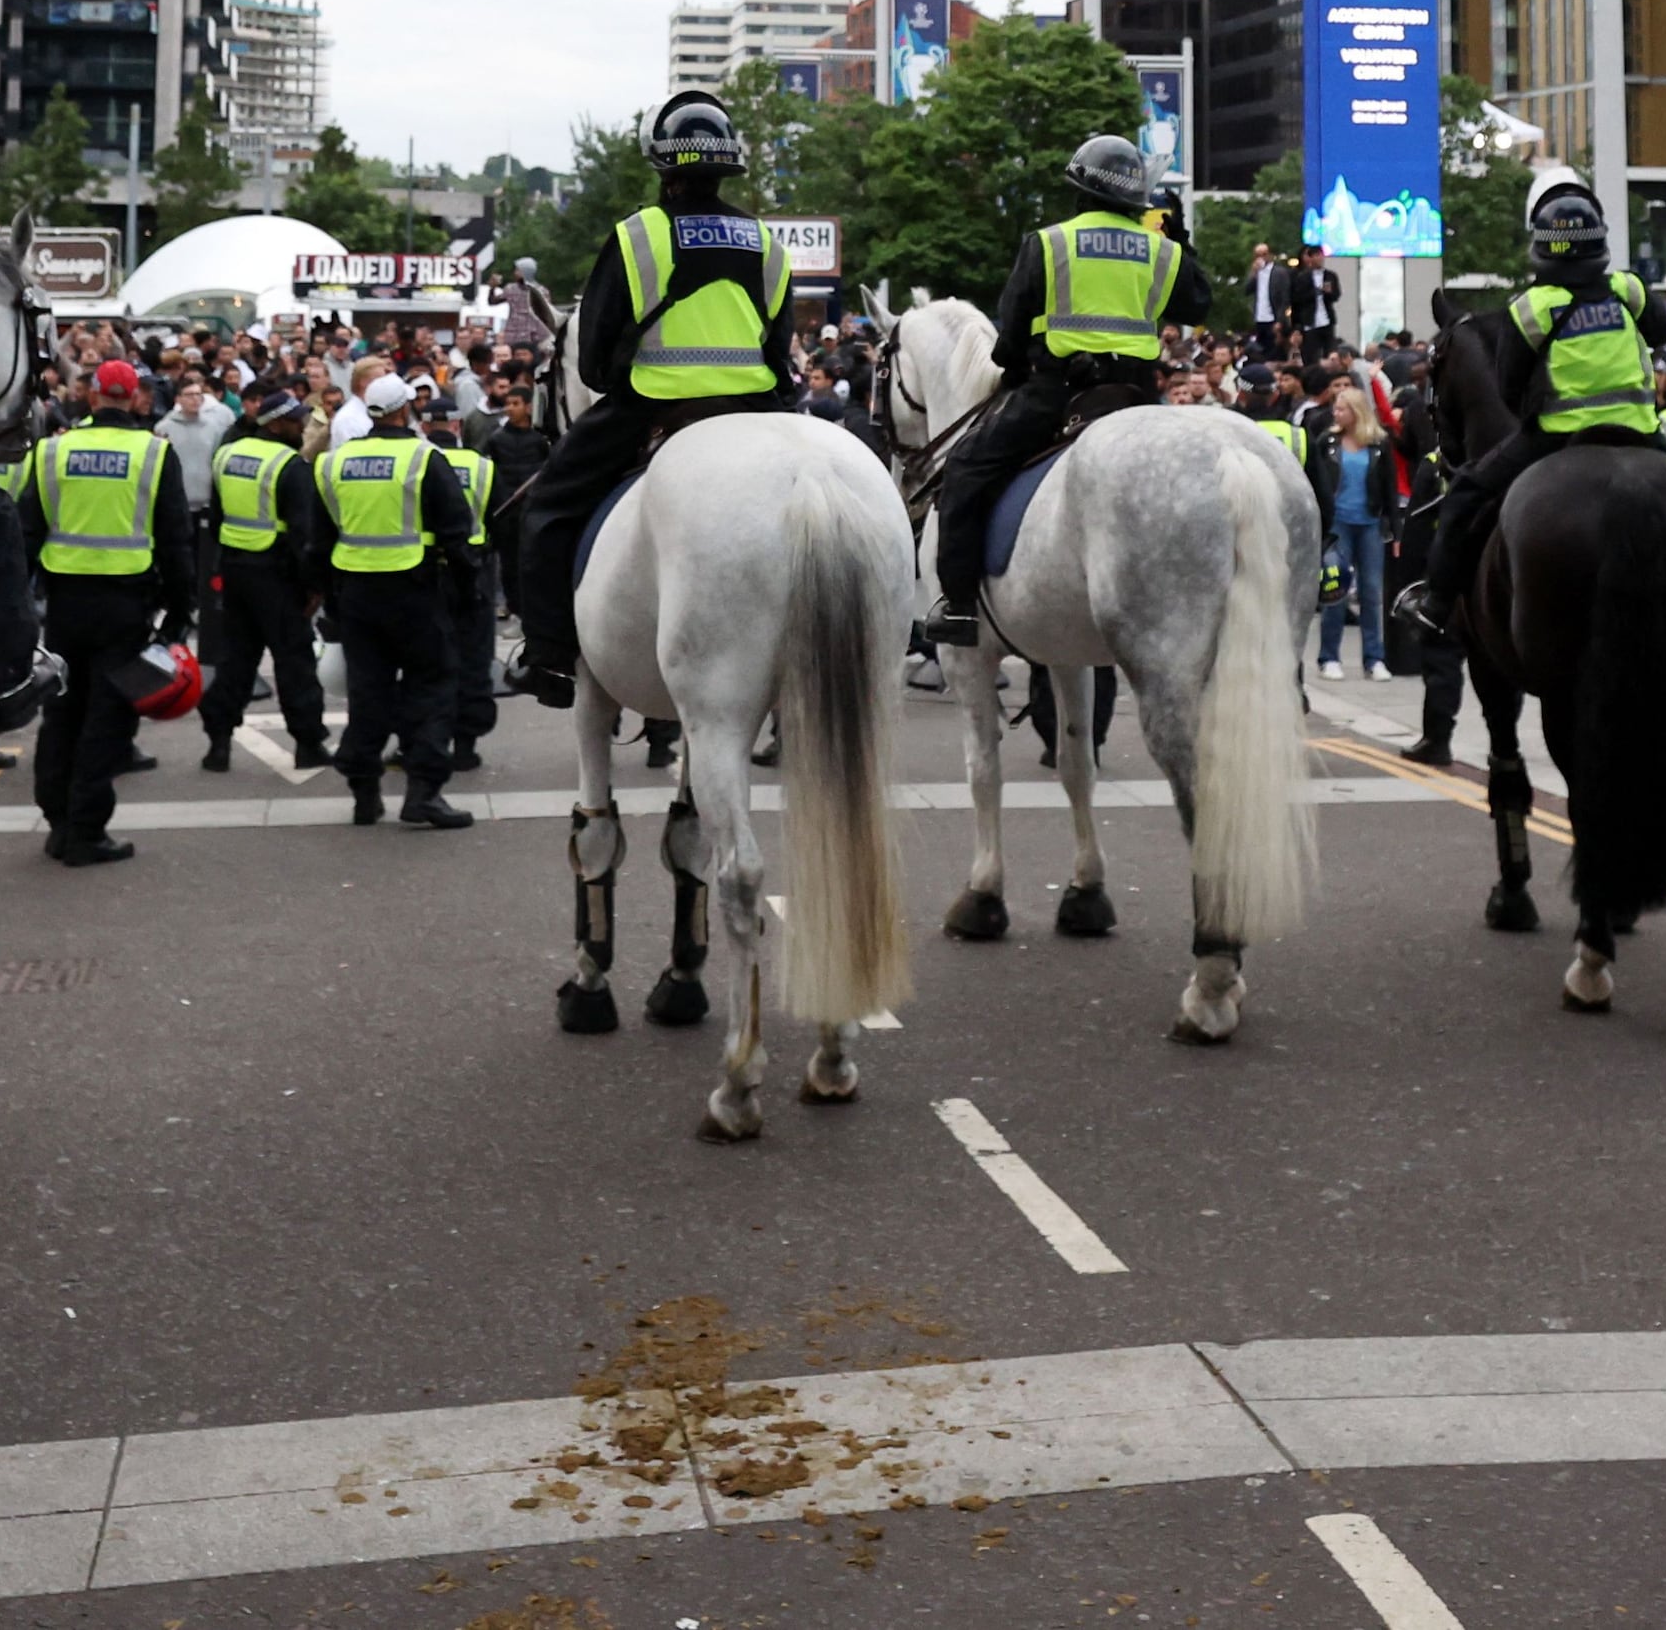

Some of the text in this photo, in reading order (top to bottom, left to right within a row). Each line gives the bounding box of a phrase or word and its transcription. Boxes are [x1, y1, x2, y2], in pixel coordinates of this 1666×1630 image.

[676, 151, 701, 166] MP
[682, 227, 761, 247] POLICE
[769, 226, 831, 247] MASH
[1078, 232, 1148, 258] POLICE
[297, 255, 475, 286] LOADED FRIES
[1554, 302, 1622, 332] OLICE
[68, 452, 127, 475] POLICE
[343, 458, 394, 478] POLICE
